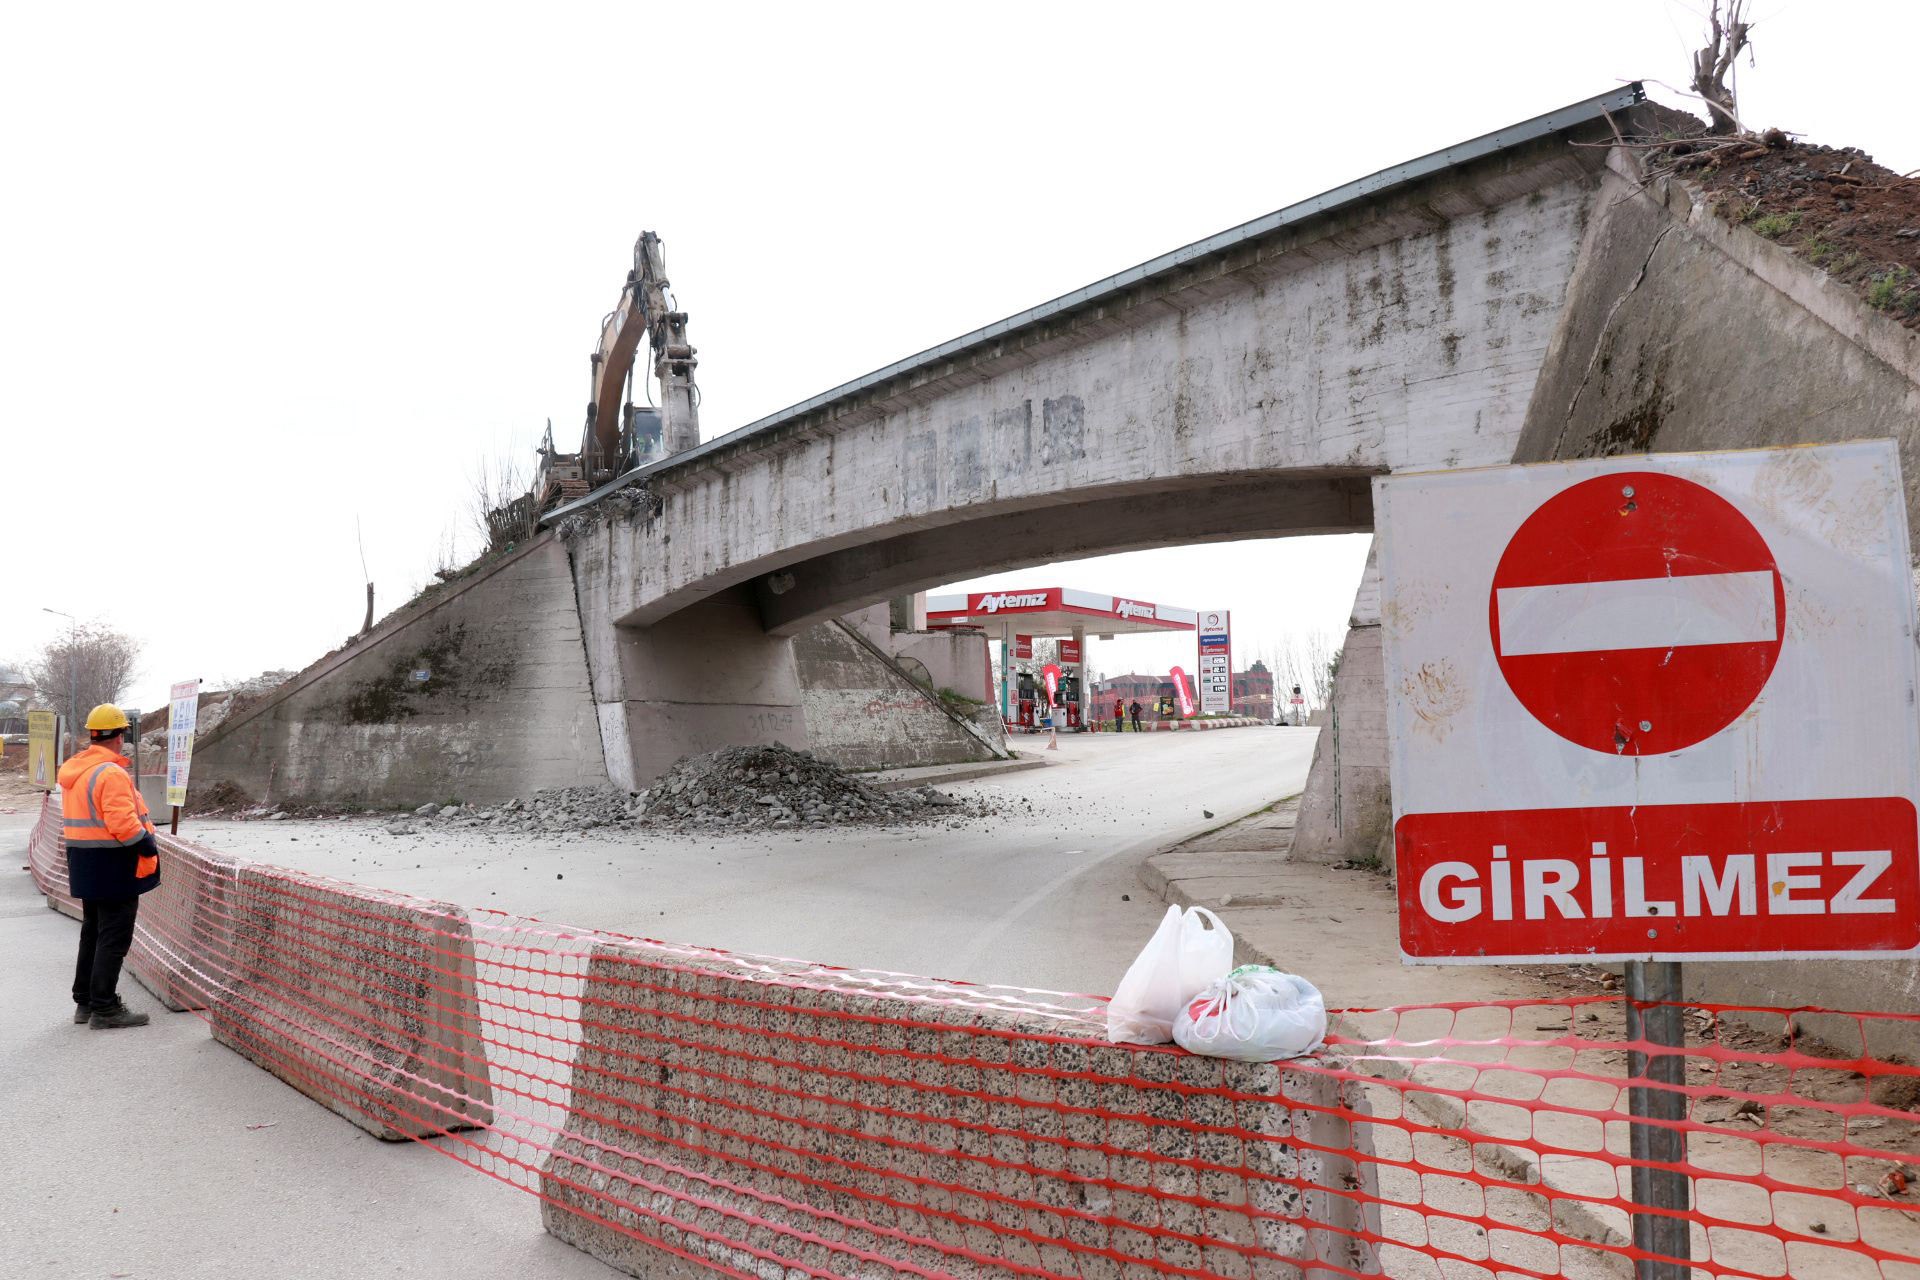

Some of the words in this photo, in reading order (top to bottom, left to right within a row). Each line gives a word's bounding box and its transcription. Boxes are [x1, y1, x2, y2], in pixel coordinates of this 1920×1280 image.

[976, 592, 1048, 613] Aytemiz
[1116, 600, 1155, 618] Aytemiz
[1418, 841, 1897, 923] GİRİLMEZ
